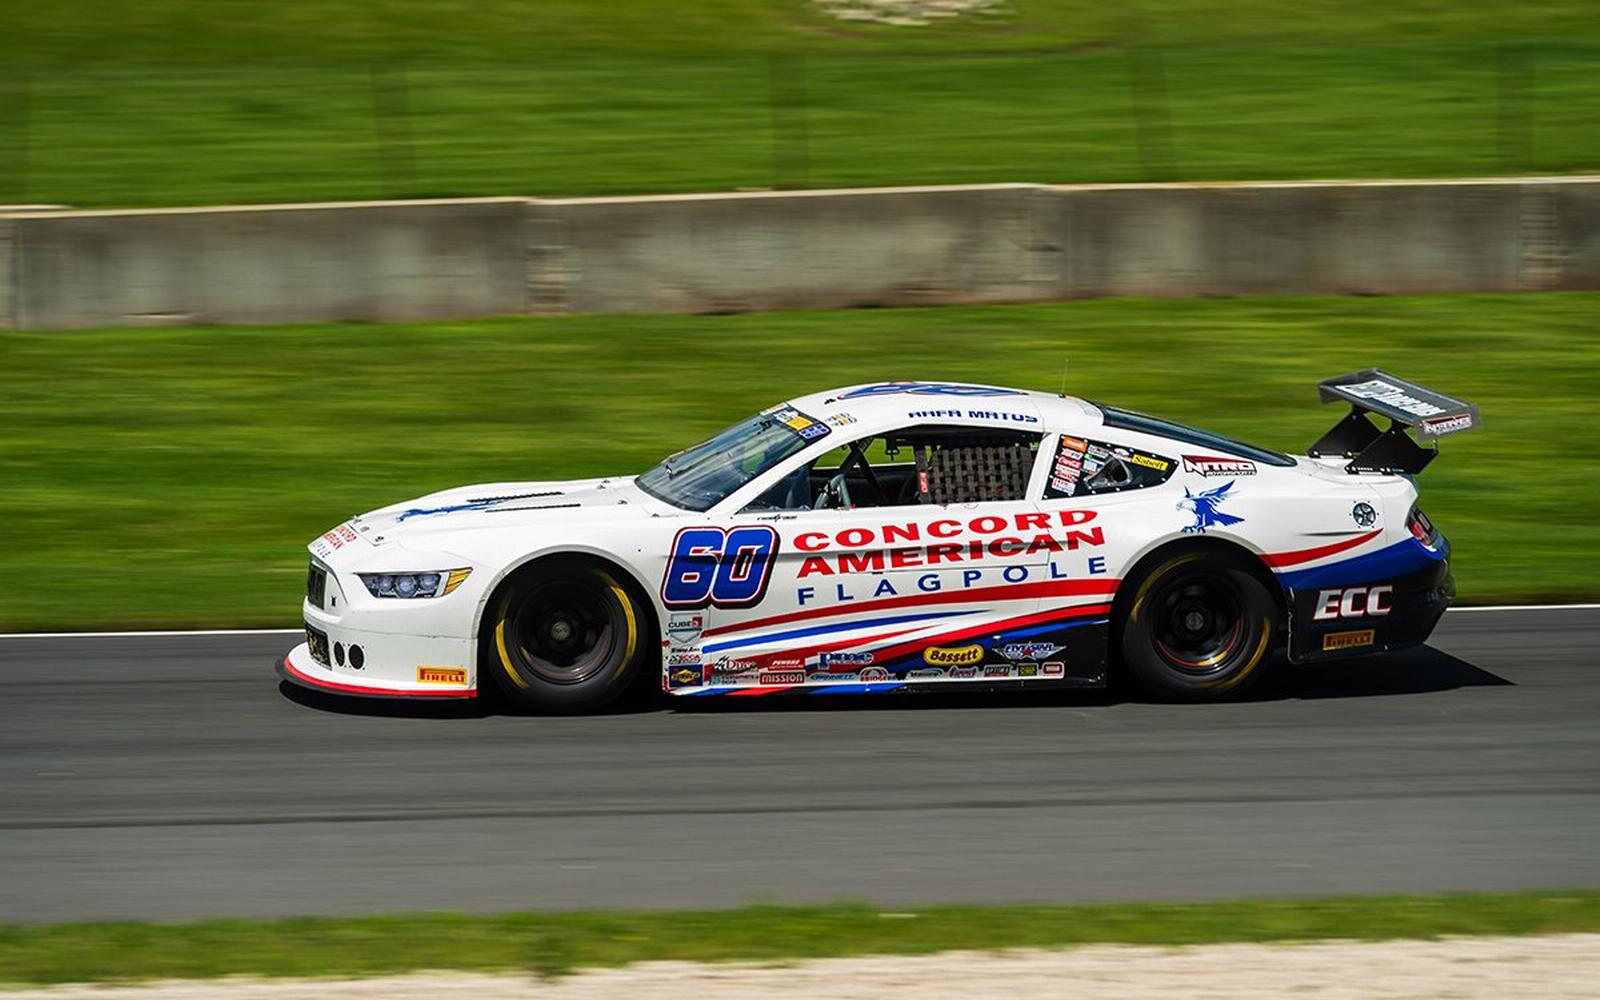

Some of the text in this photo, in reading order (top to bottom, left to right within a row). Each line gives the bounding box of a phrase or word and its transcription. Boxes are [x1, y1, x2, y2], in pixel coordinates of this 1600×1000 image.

[968, 410, 1038, 423] MATOS
[1182, 455, 1257, 477] NITRO
[794, 510, 1098, 551] CONCORD
[660, 525, 781, 611] 60
[797, 527, 1105, 578] AMERICAN
[798, 557, 1107, 605] FLAGPOLE
[1313, 586, 1393, 620] ECC
[930, 647, 979, 663] Bassett
[420, 668, 465, 683] PIRELLI
